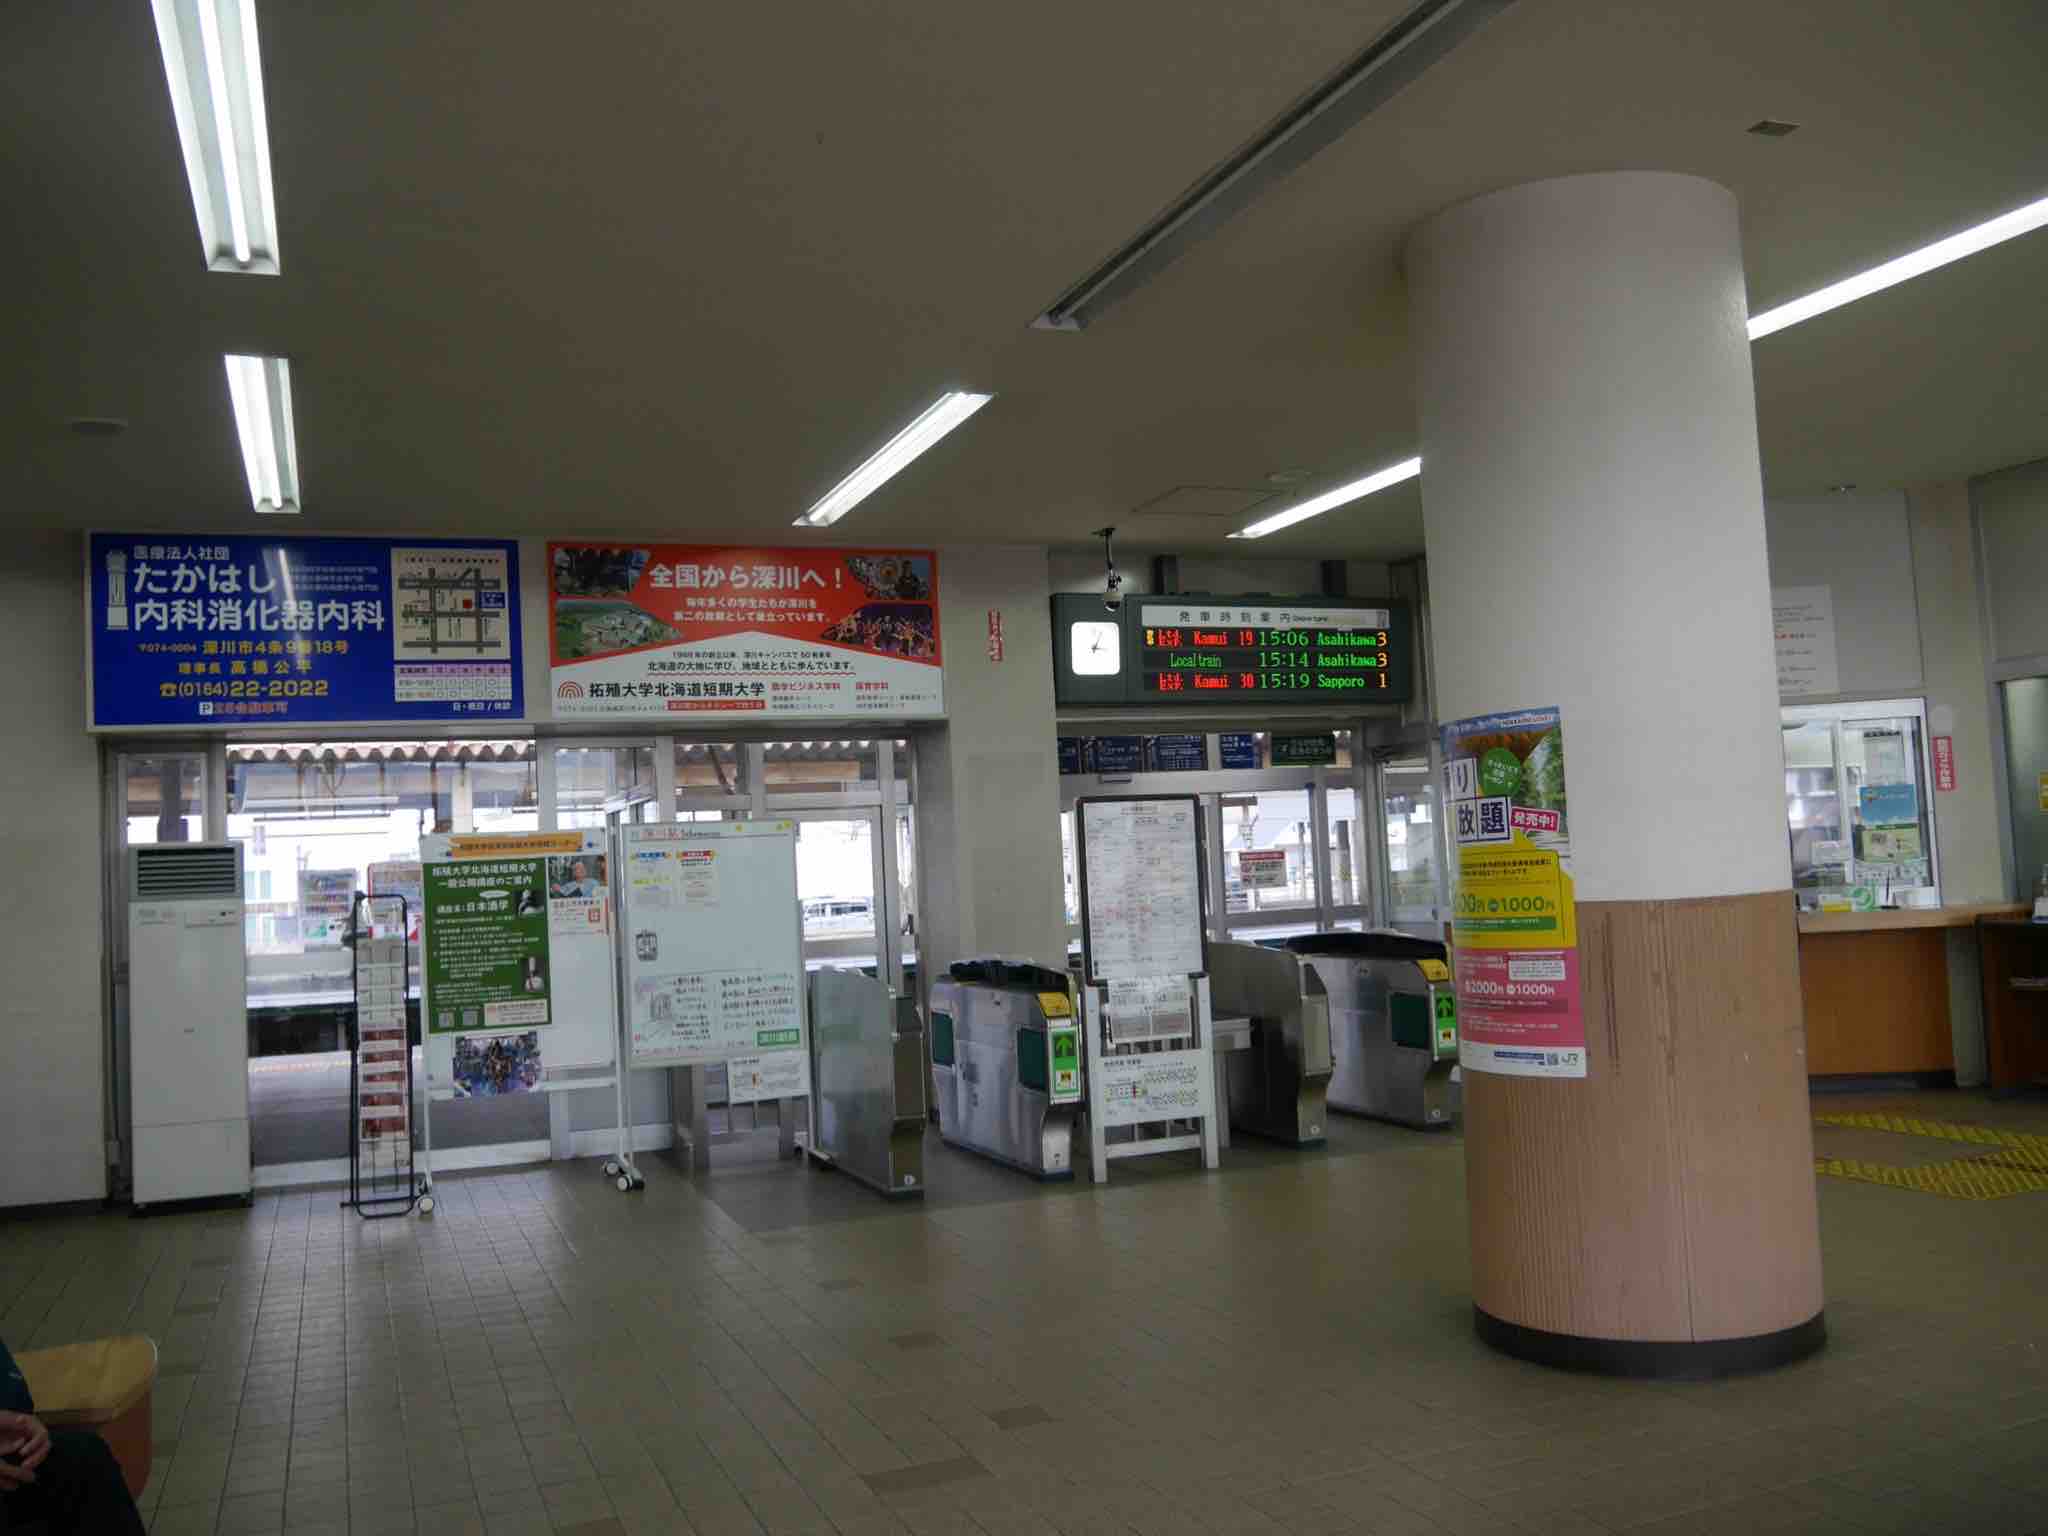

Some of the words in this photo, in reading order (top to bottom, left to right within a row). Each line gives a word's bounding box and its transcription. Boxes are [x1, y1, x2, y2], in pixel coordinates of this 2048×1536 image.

[132, 562, 277, 594] たかはし
[134, 600, 385, 632] 内科消化器内科
[1259, 631, 1309, 647] 15:06
[1316, 632, 1377, 647] Asahikawa
[1377, 632, 1388, 647] 3
[1259, 652, 1309, 668] 15:14
[1316, 654, 1377, 668] Asahikawa
[1377, 653, 1388, 668] 3
[178, 680, 329, 698] (0164)22-2022
[589, 682, 766, 698] 拓殖大学北海道短期大学
[1259, 673, 1310, 689] 15:19
[1317, 673, 1365, 690] Sapporo
[1379, 674, 1387, 688] 1
[1457, 800, 1506, 835] 放題
